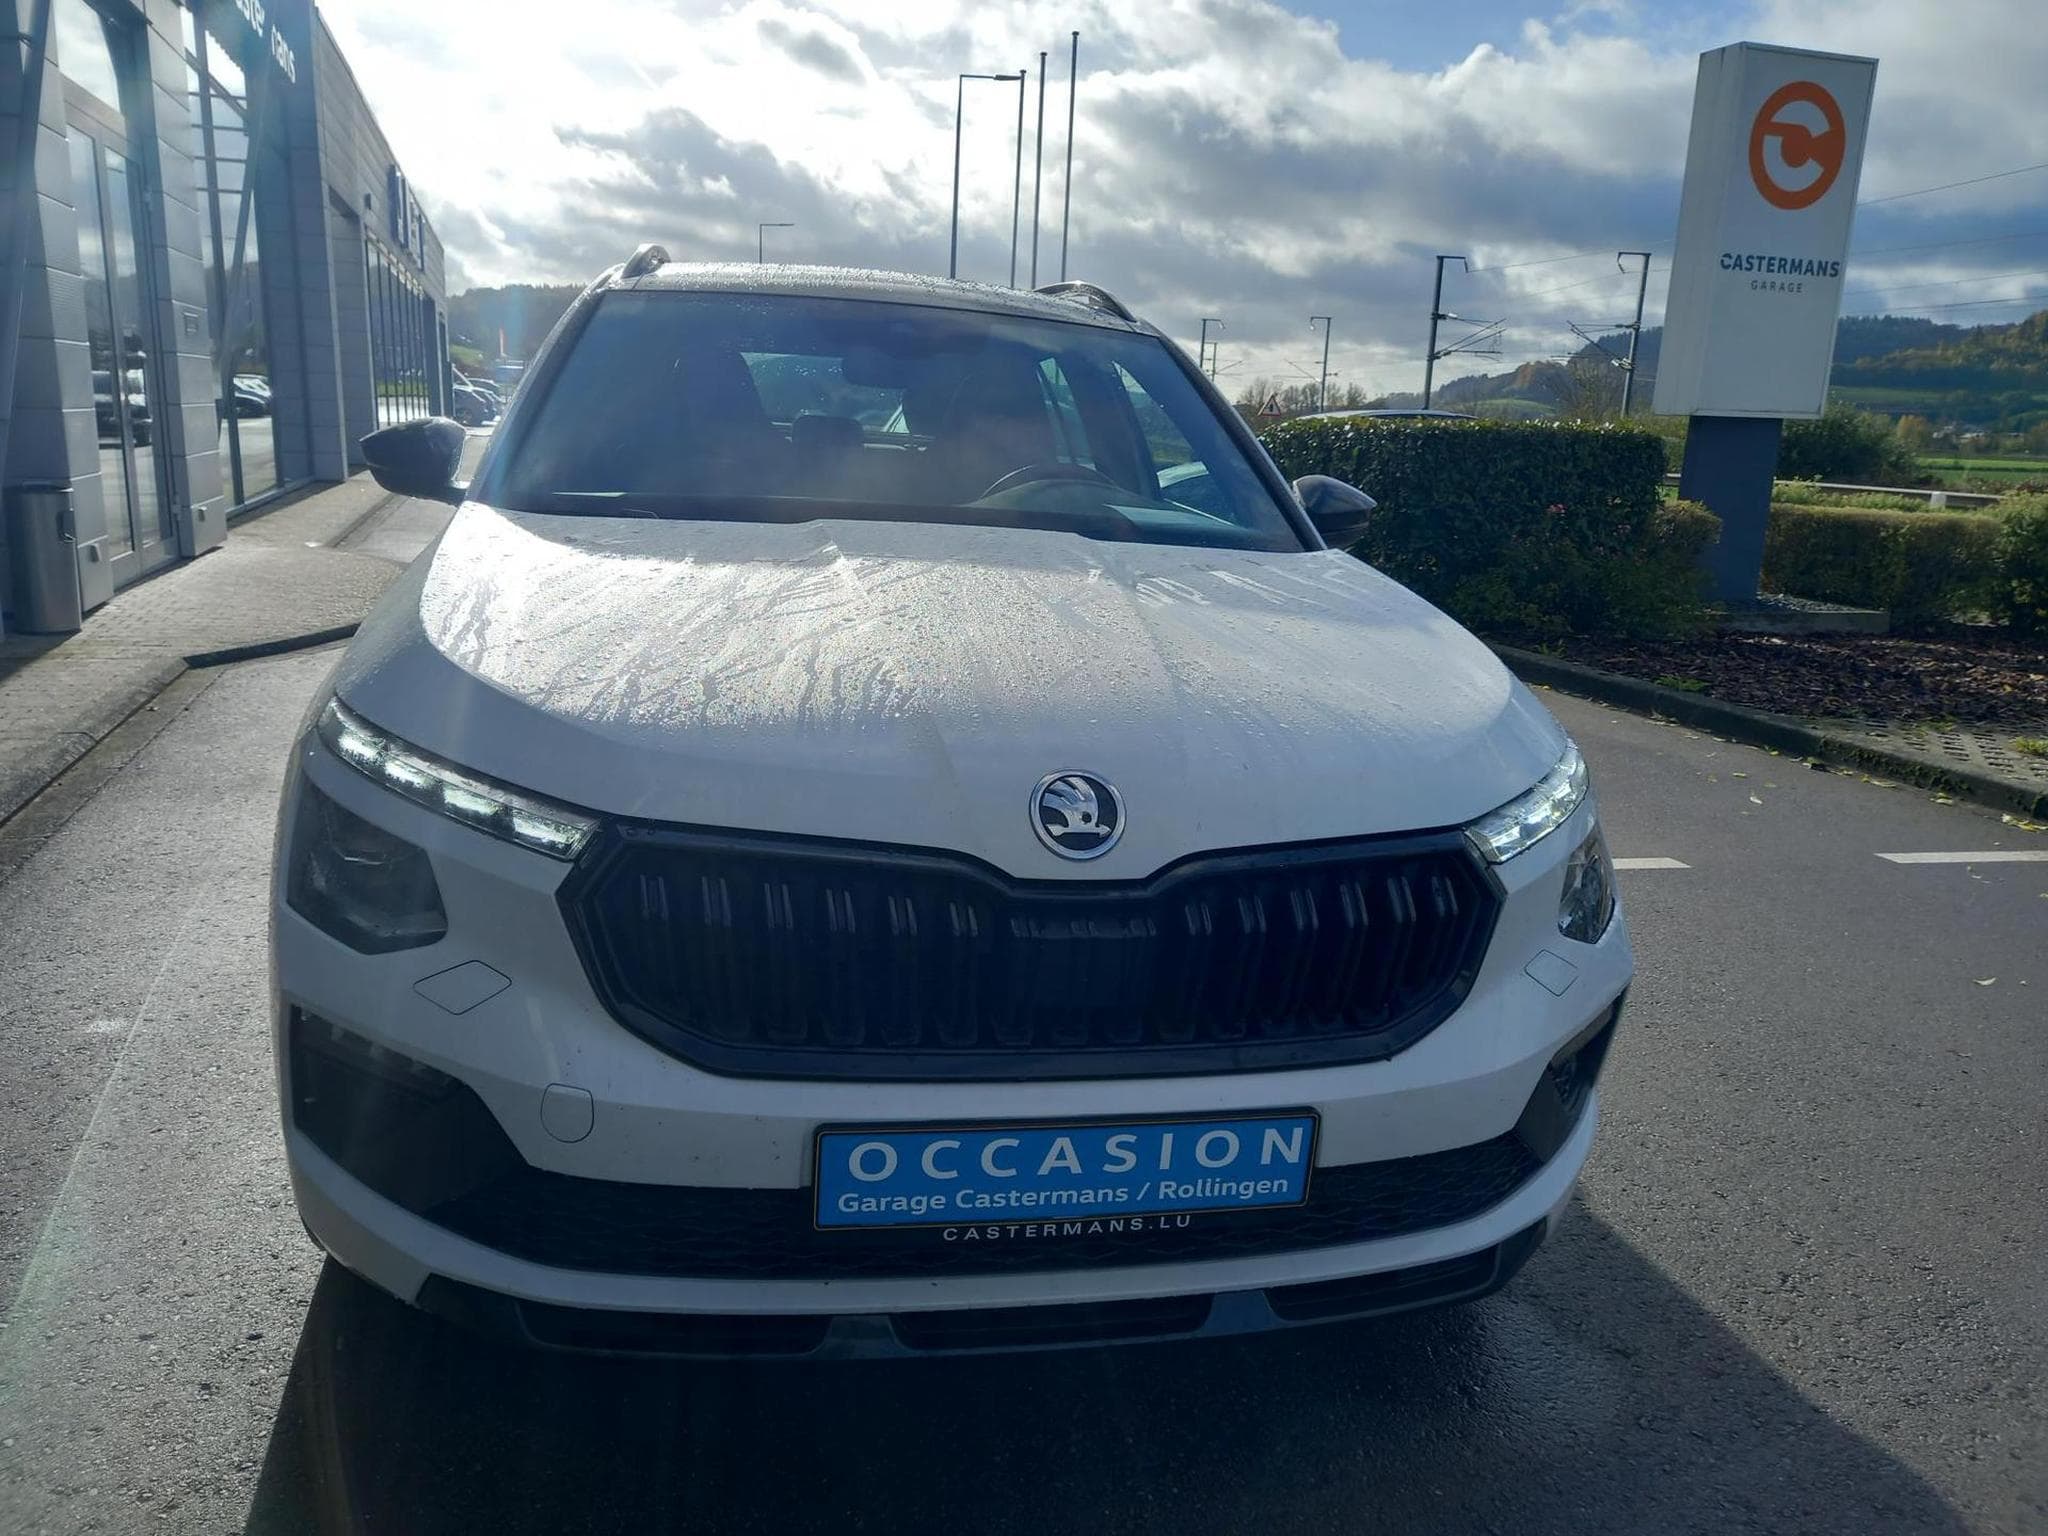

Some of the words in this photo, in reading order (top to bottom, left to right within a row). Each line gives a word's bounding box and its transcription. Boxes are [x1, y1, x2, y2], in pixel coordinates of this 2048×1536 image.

[1720, 253, 1841, 278] CASTERMANS
[1750, 280, 1803, 293] GARAGE
[848, 1127, 1304, 1182] OCCASION
[838, 1193, 946, 1215] Garage
[955, 1186, 1129, 1209] Castermans
[1136, 1182, 1151, 1201] /
[1158, 1178, 1289, 1200] Rollingen
[942, 1214, 1191, 1241] CASTERMANS.LU
